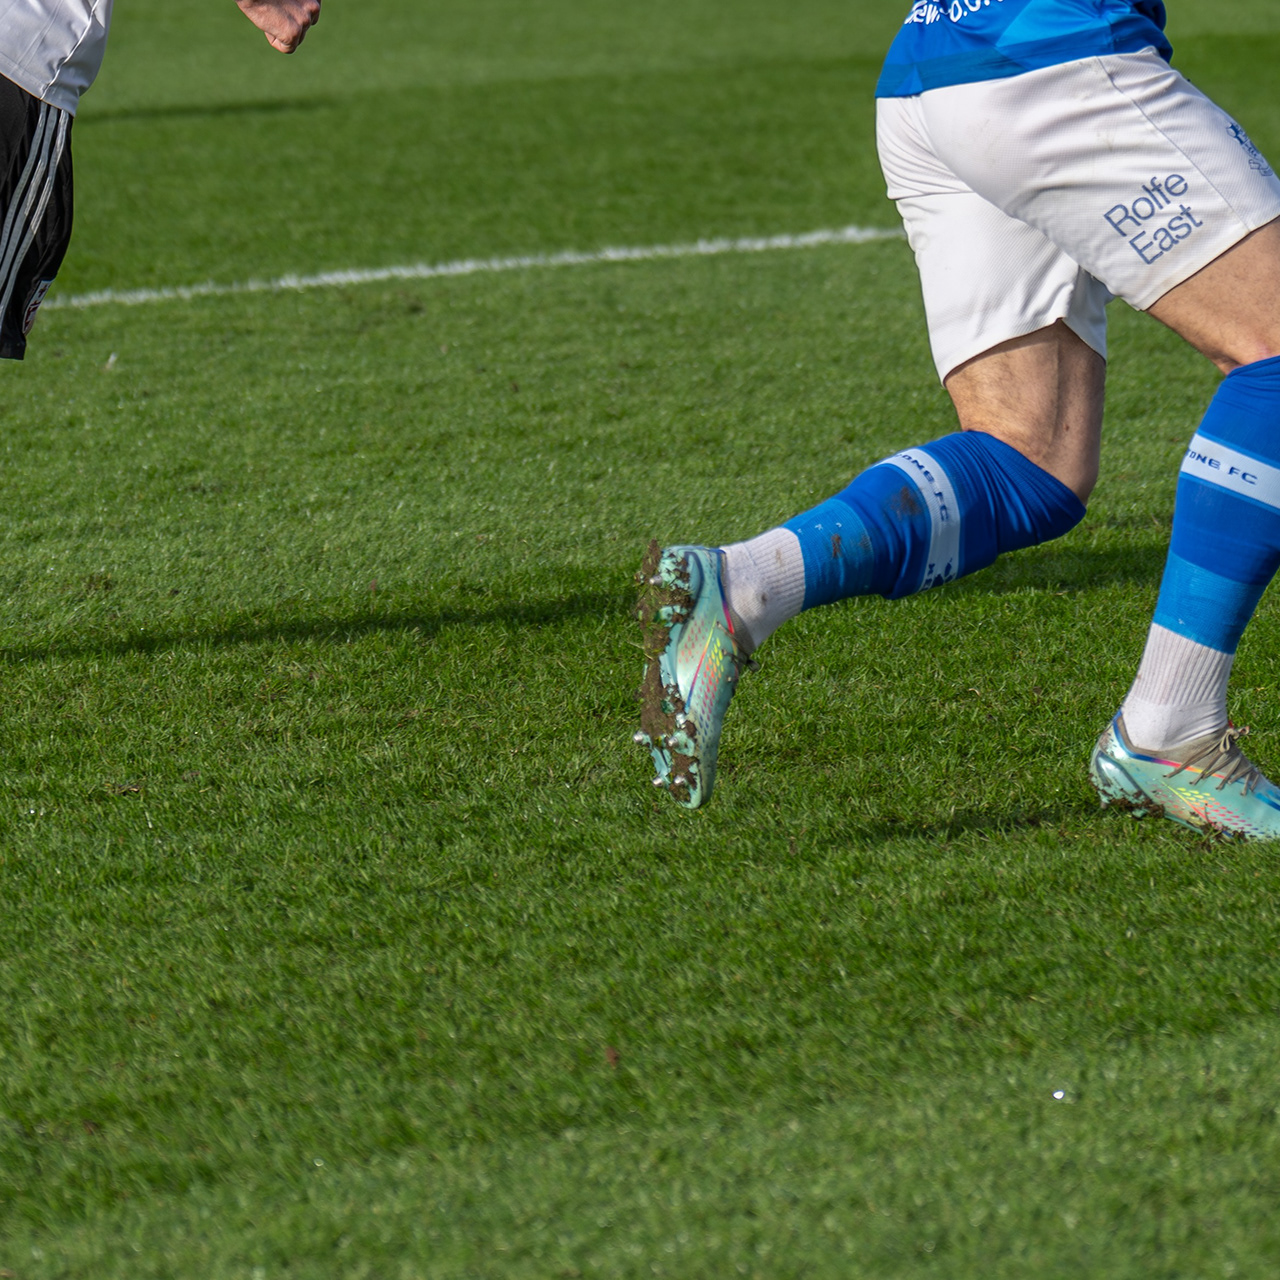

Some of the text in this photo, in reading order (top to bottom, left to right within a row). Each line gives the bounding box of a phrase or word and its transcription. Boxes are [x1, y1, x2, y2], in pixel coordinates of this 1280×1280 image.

[1103, 173, 1189, 238] Rolfe
[1128, 204, 1204, 265] East
[1228, 466, 1258, 485] FC
